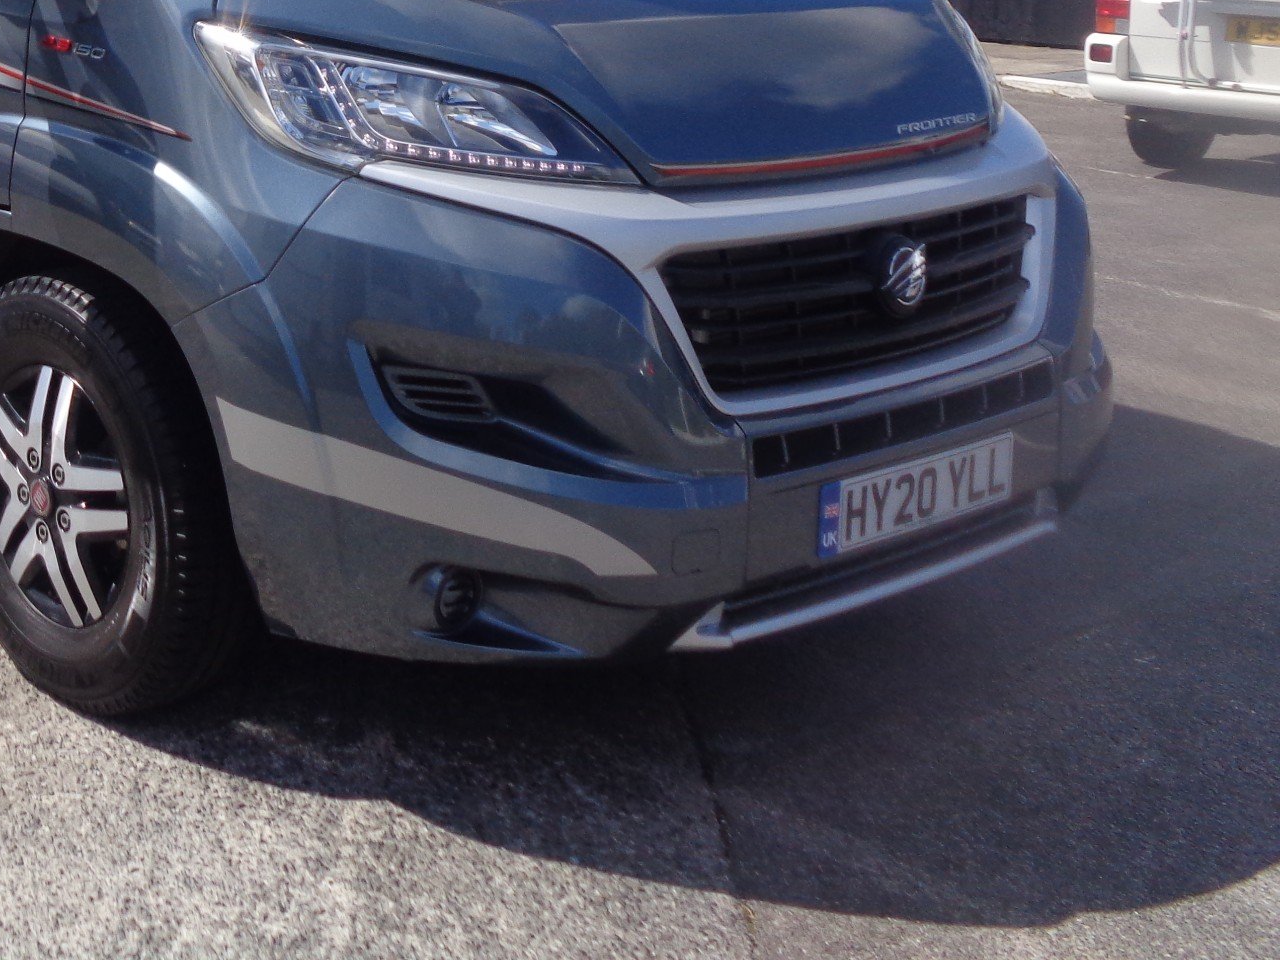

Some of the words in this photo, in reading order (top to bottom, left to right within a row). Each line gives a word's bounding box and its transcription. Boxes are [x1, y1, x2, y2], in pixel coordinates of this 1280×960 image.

[896, 112, 976, 135] FRONTIER
[845, 467, 938, 540] HY20
[949, 448, 1005, 508] YLL
[822, 531, 838, 548] UK
